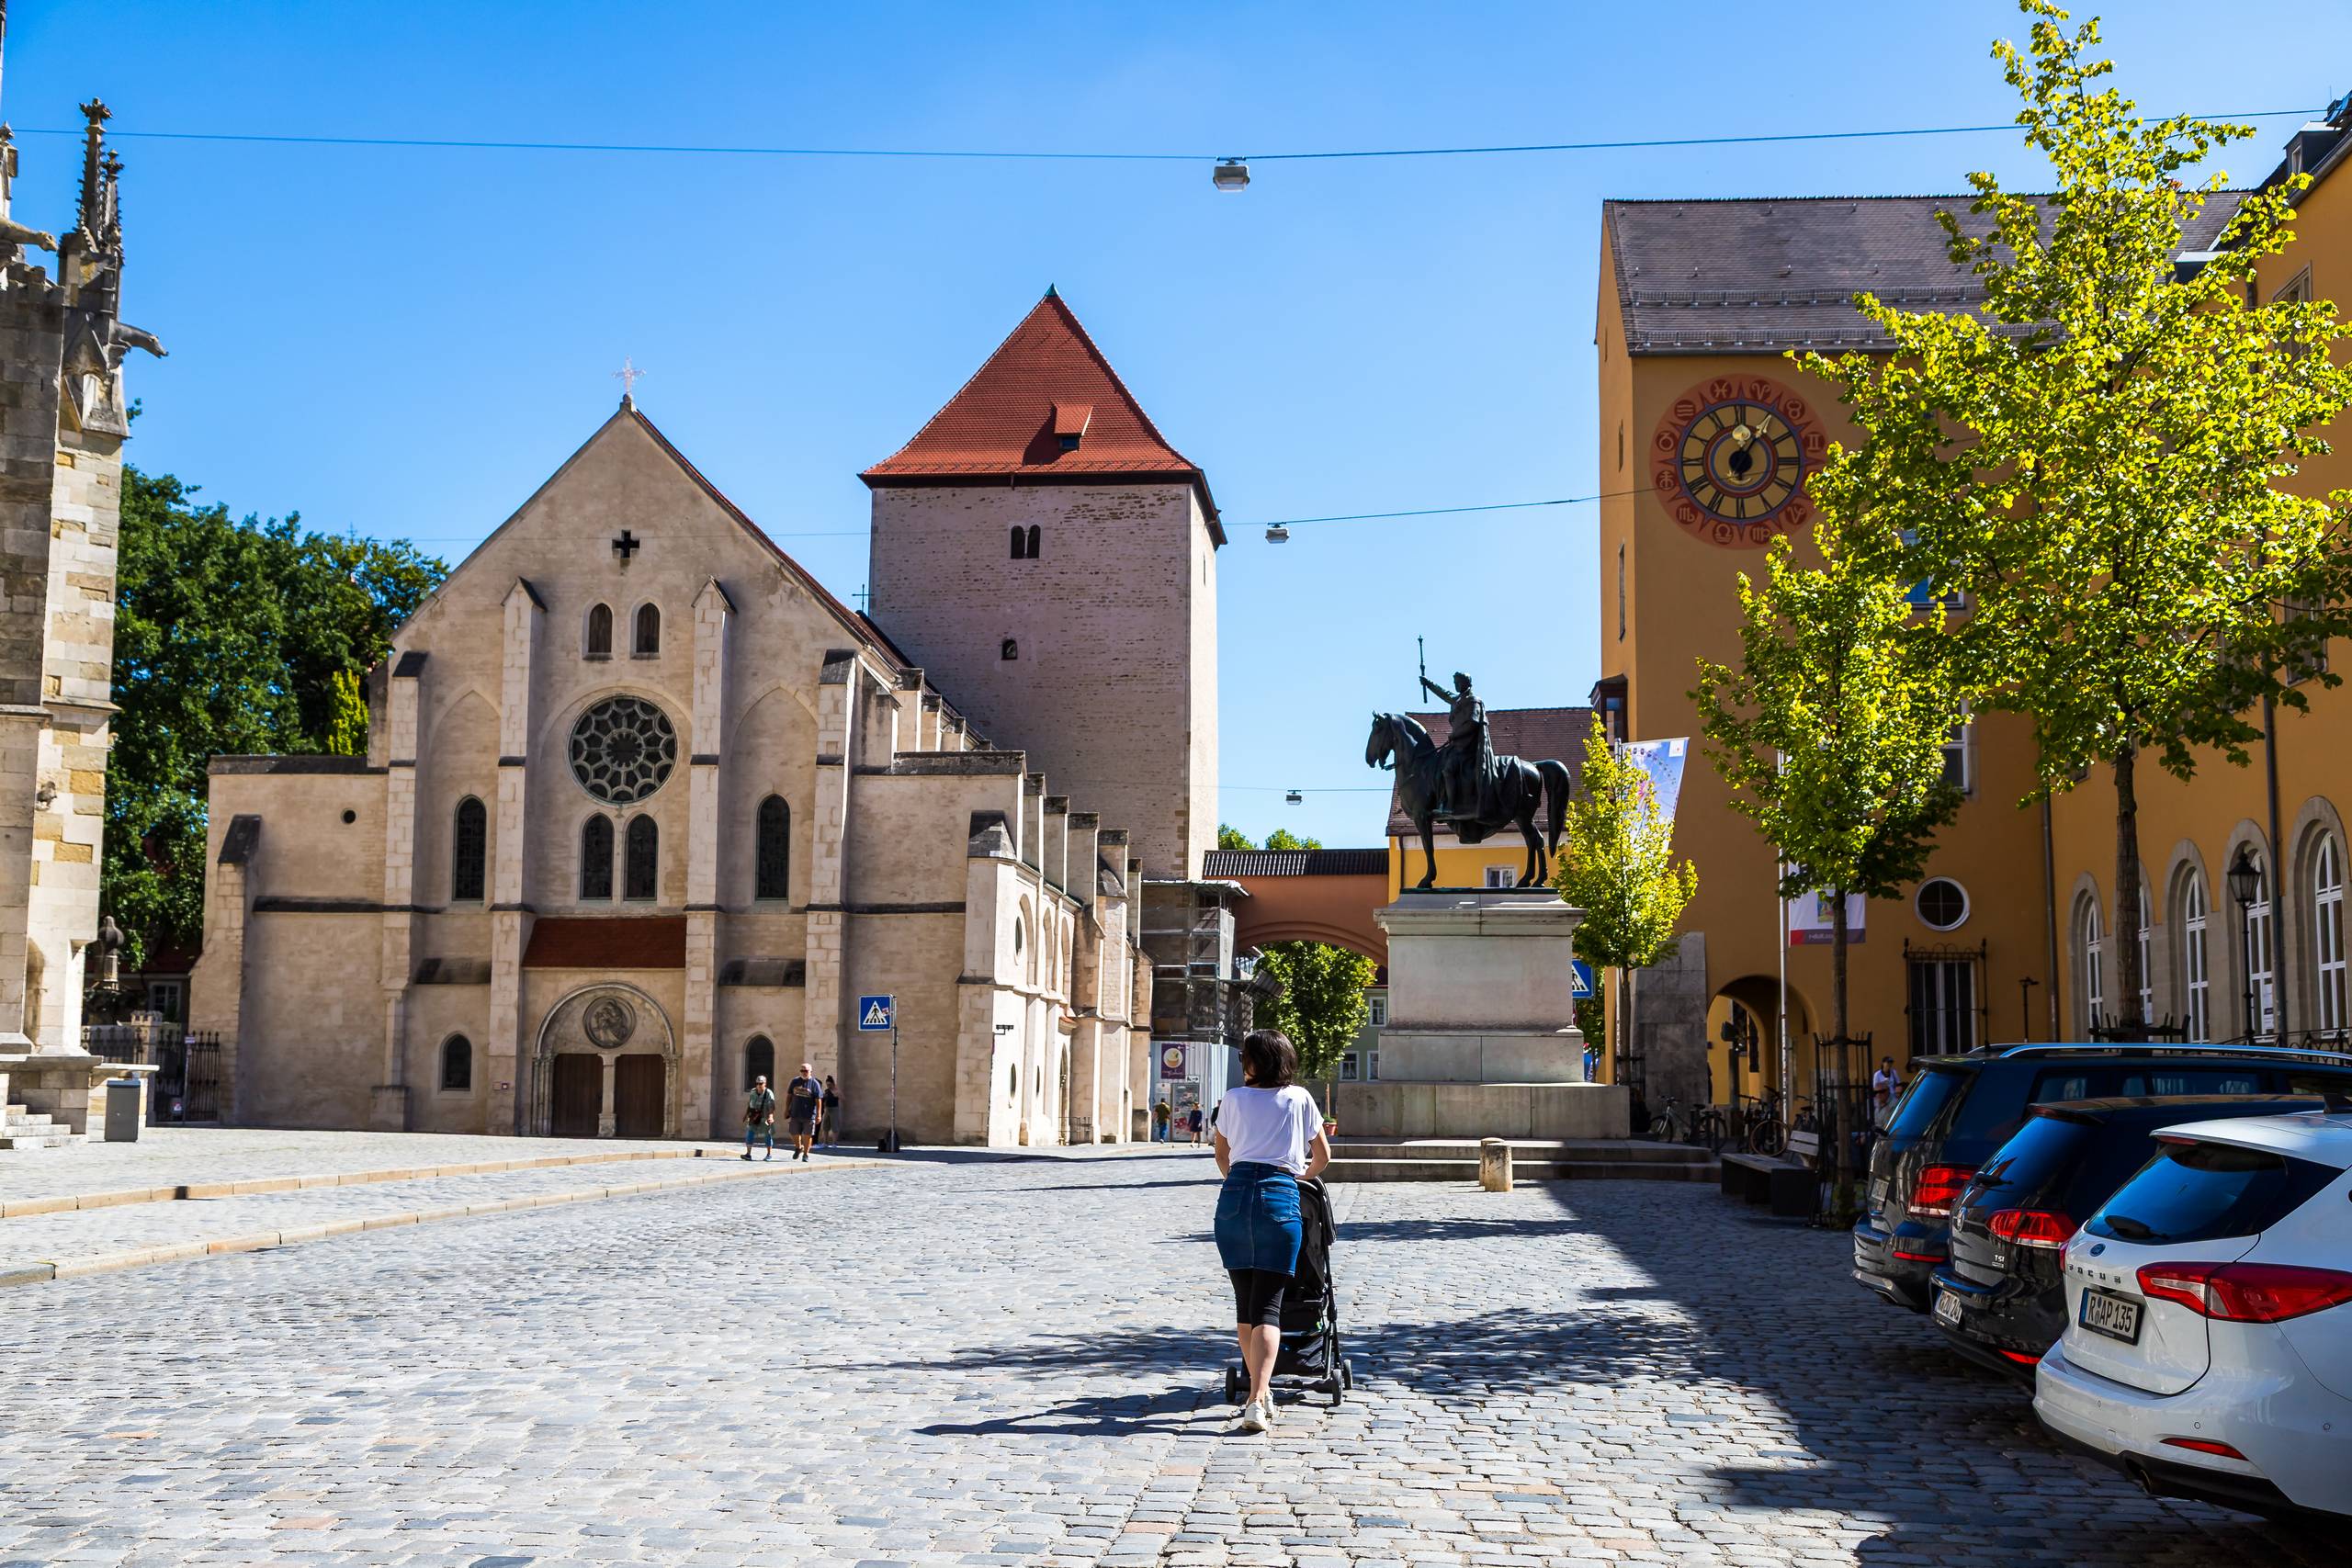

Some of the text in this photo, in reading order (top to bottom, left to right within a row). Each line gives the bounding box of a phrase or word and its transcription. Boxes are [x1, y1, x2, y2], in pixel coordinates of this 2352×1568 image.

[1994, 1254, 2005, 1262] TSI
[2088, 1296, 2097, 1322] R
[2099, 1300, 2113, 1325] AP
[2113, 1303, 2133, 1333] 135
